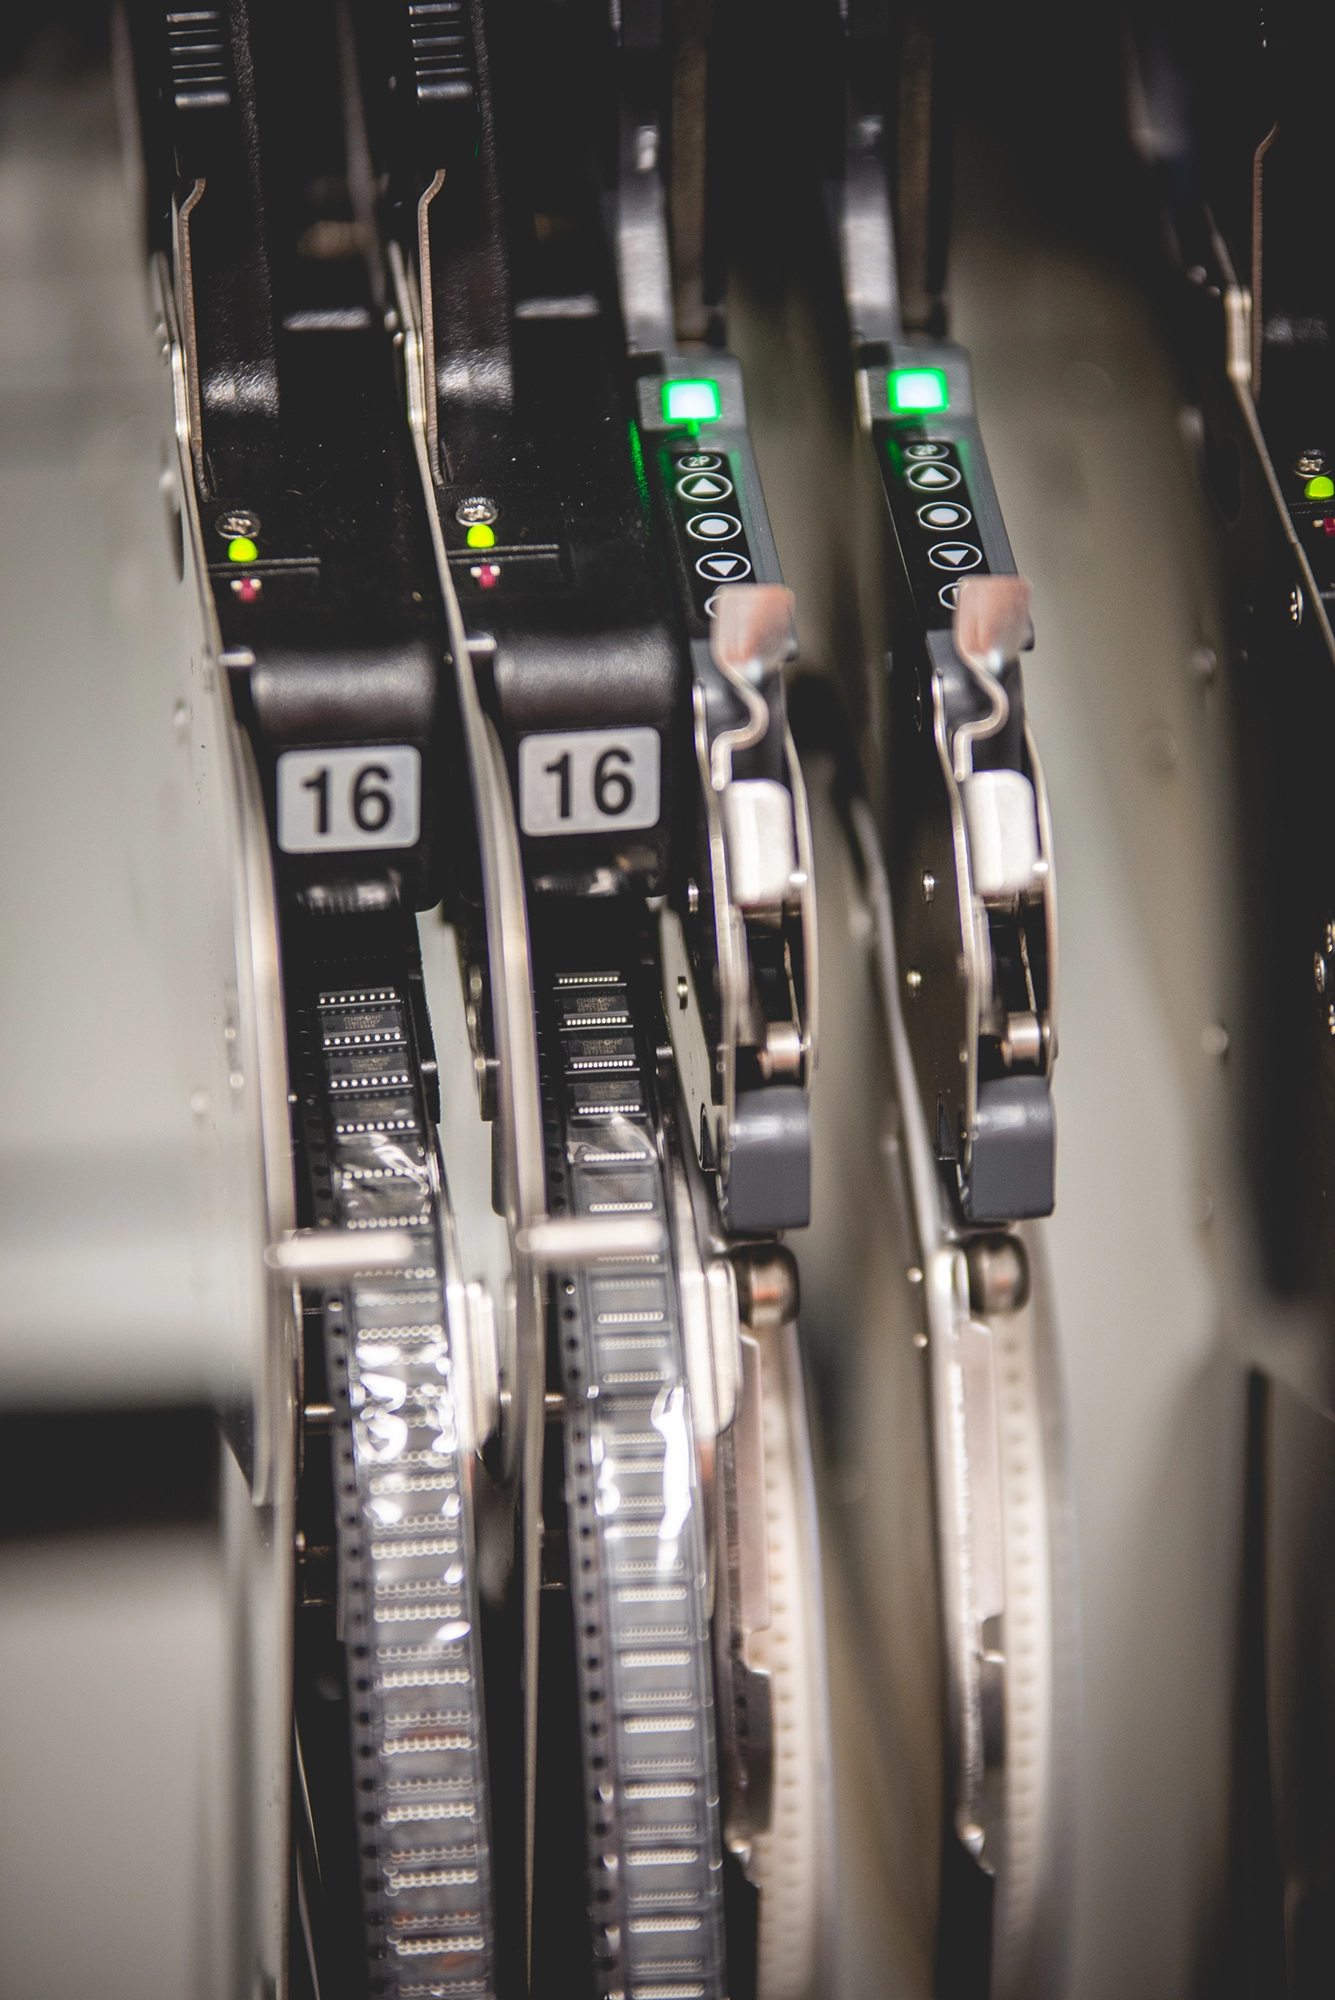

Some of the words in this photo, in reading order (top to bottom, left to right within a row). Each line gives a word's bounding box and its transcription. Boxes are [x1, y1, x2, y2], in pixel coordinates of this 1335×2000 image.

[689, 456, 710, 467] 2P
[917, 444, 939, 456] 2P
[302, 764, 394, 836] 16
[544, 748, 636, 820] 16
